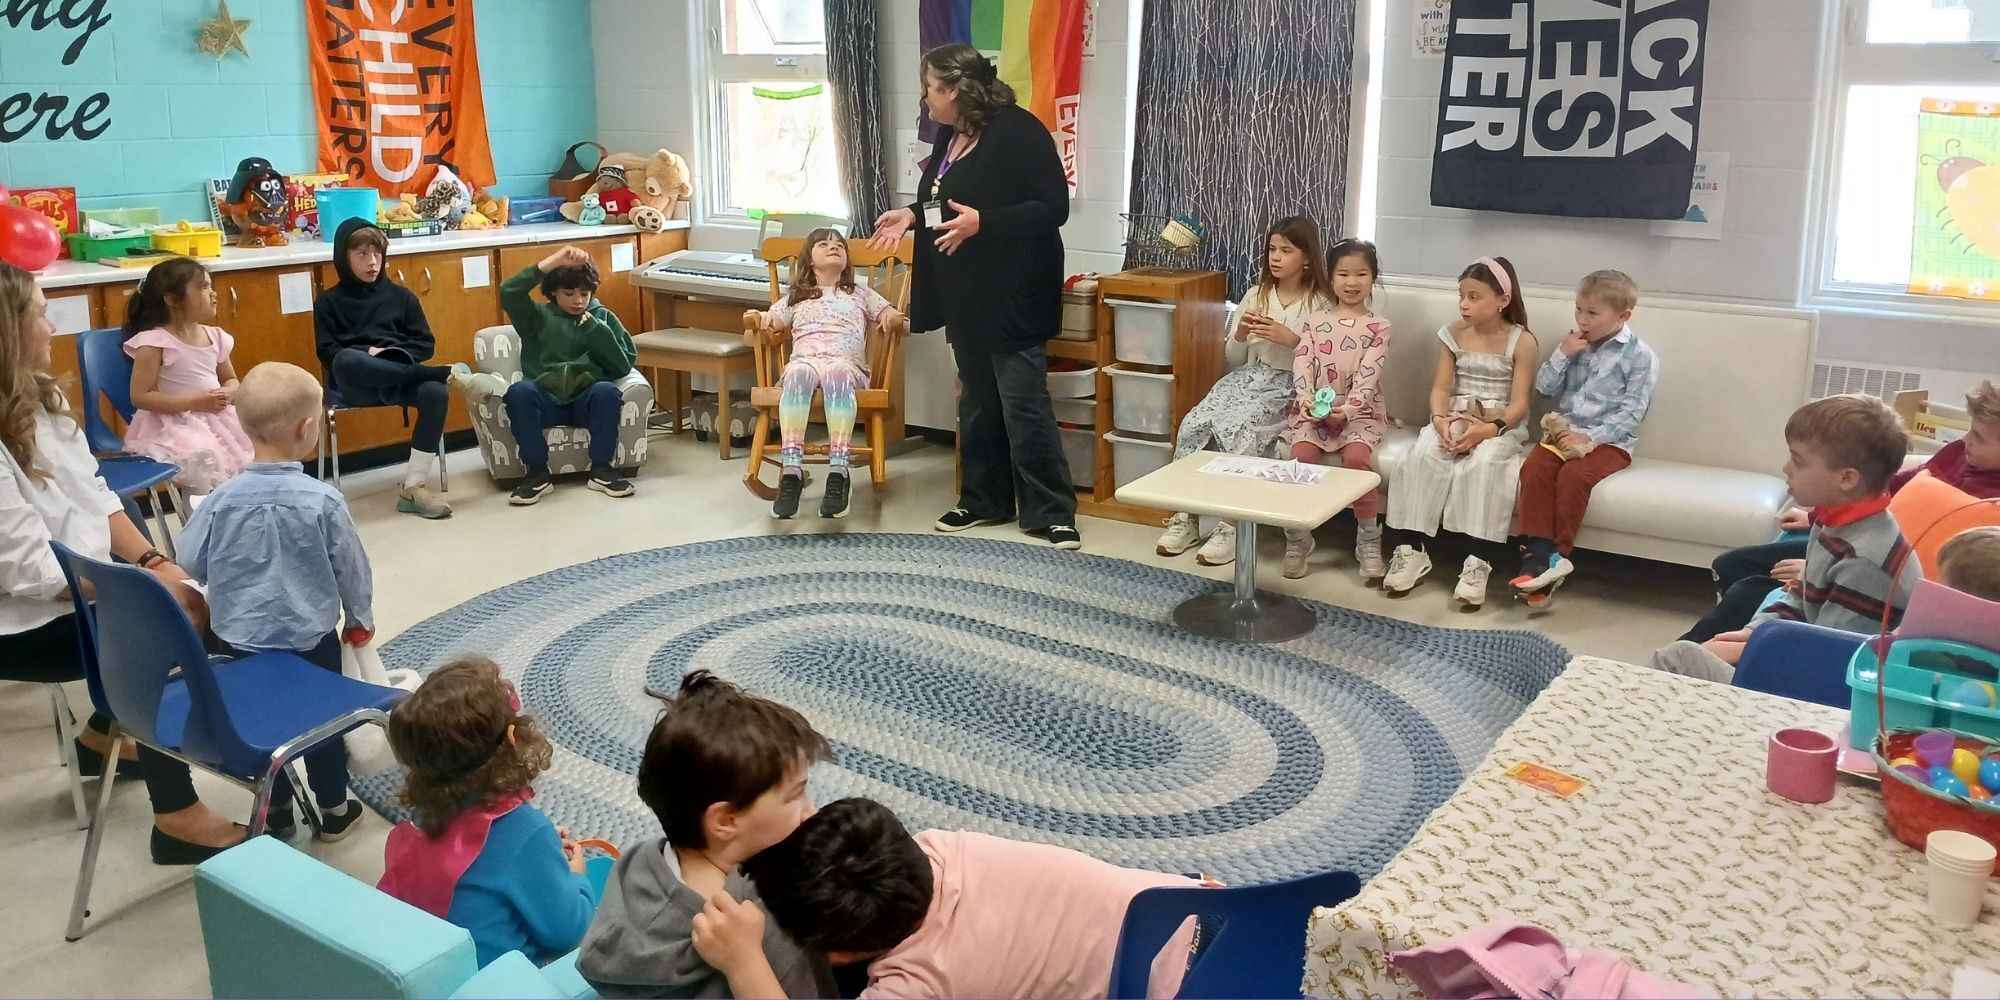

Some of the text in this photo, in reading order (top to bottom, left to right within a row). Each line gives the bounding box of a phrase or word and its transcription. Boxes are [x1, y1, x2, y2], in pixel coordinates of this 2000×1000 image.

[325, 0, 367, 180] ATTERS
[1420, 10, 1443, 20] with
[1441, 2, 1528, 152] TER
[1532, 0, 1621, 152] ES
[1622, 0, 1699, 156] CK
[1059, 102, 1078, 187] EVERY
